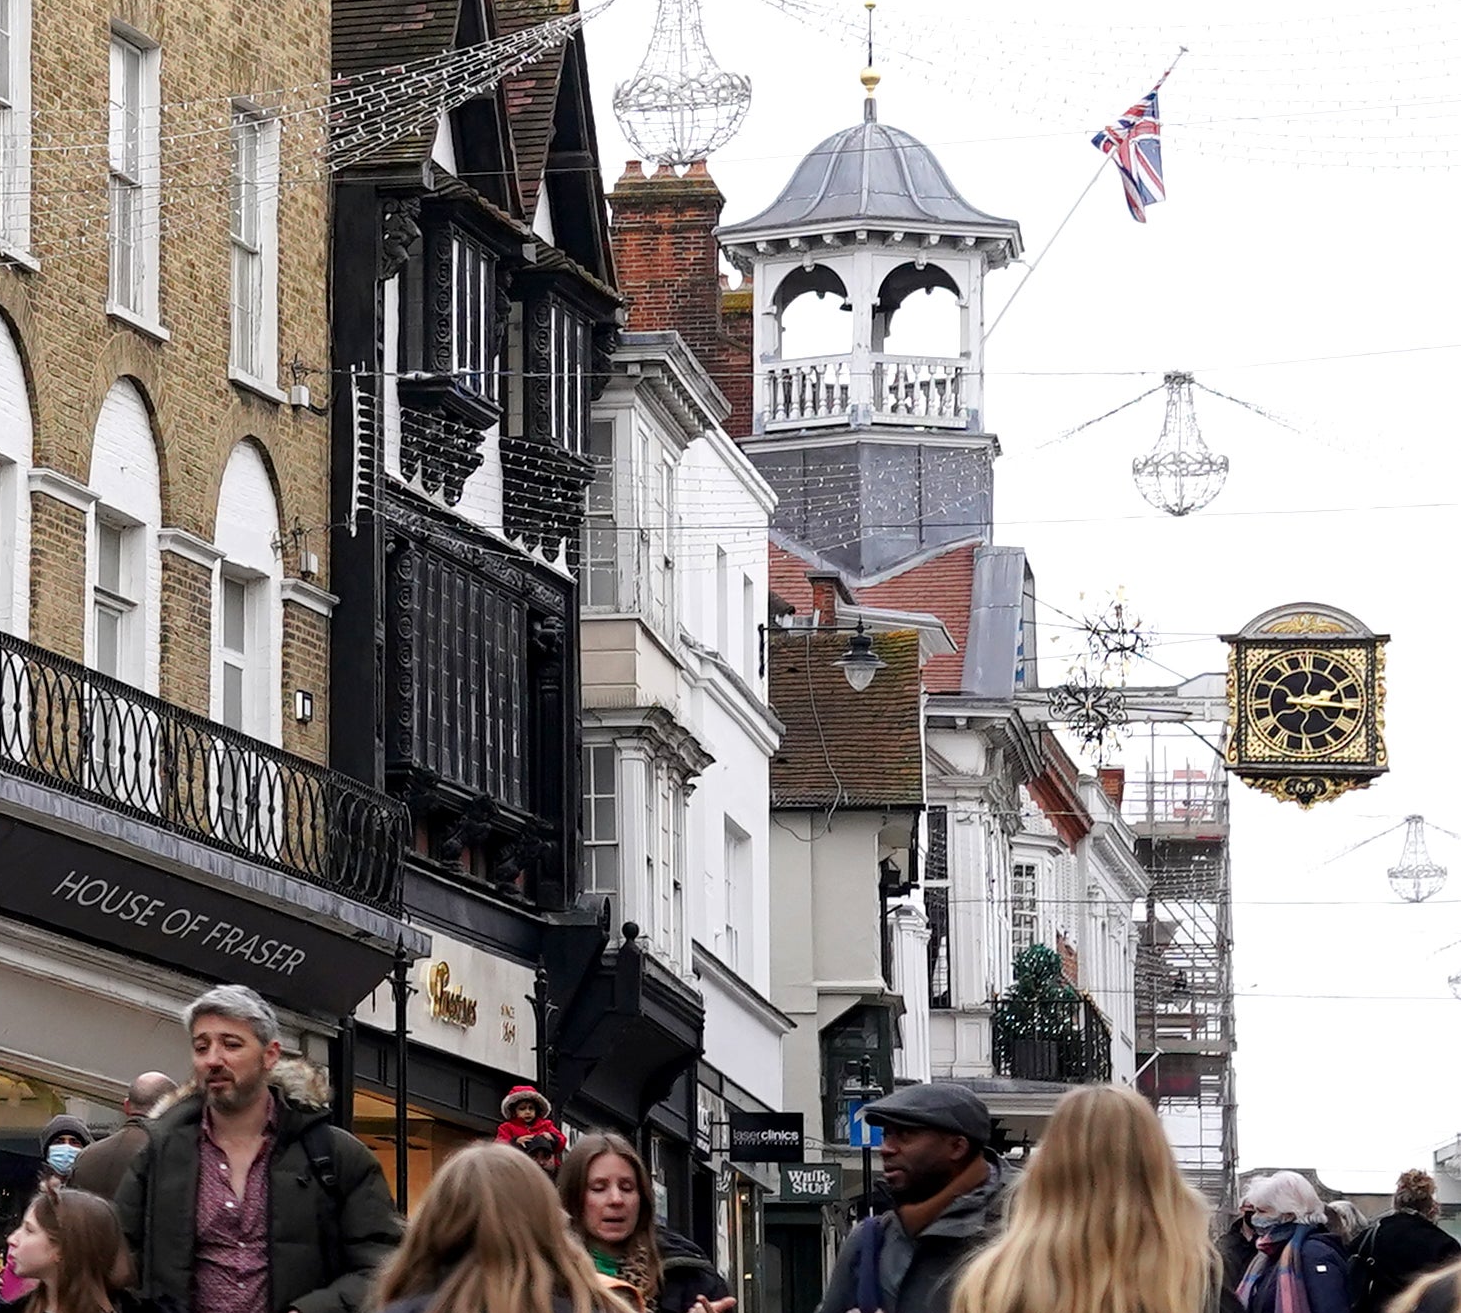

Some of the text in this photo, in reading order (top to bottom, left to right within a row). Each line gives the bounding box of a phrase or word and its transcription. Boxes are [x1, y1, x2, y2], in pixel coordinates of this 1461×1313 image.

[52, 870, 307, 976] HOUSE OF FRASER
